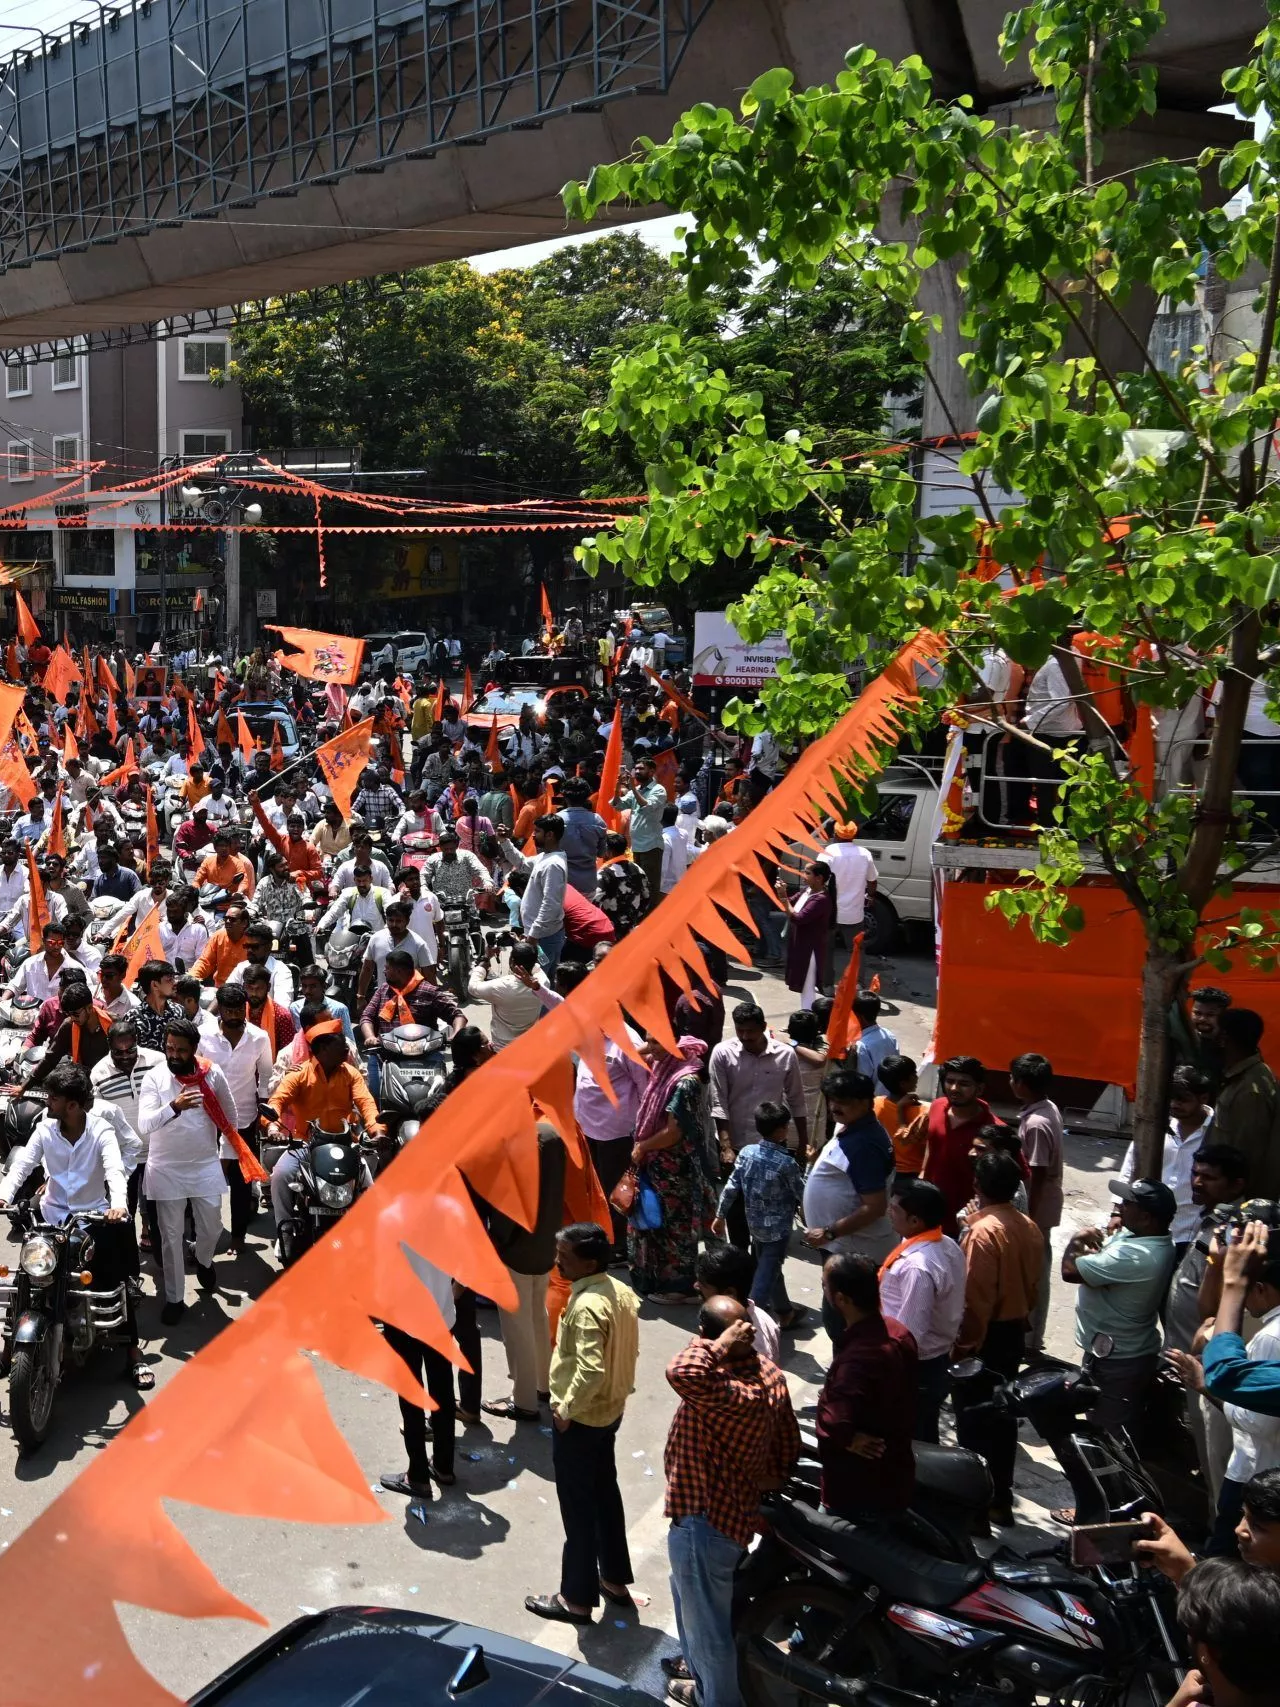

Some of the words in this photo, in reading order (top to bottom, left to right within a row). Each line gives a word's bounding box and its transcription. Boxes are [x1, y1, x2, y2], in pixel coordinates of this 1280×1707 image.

[60, 596, 78, 604] ROYAL
[80, 596, 107, 606] FASHION
[736, 666, 770, 675] HEARING
[725, 677, 746, 685] 9000
[1065, 1607, 1096, 1625] Hero
